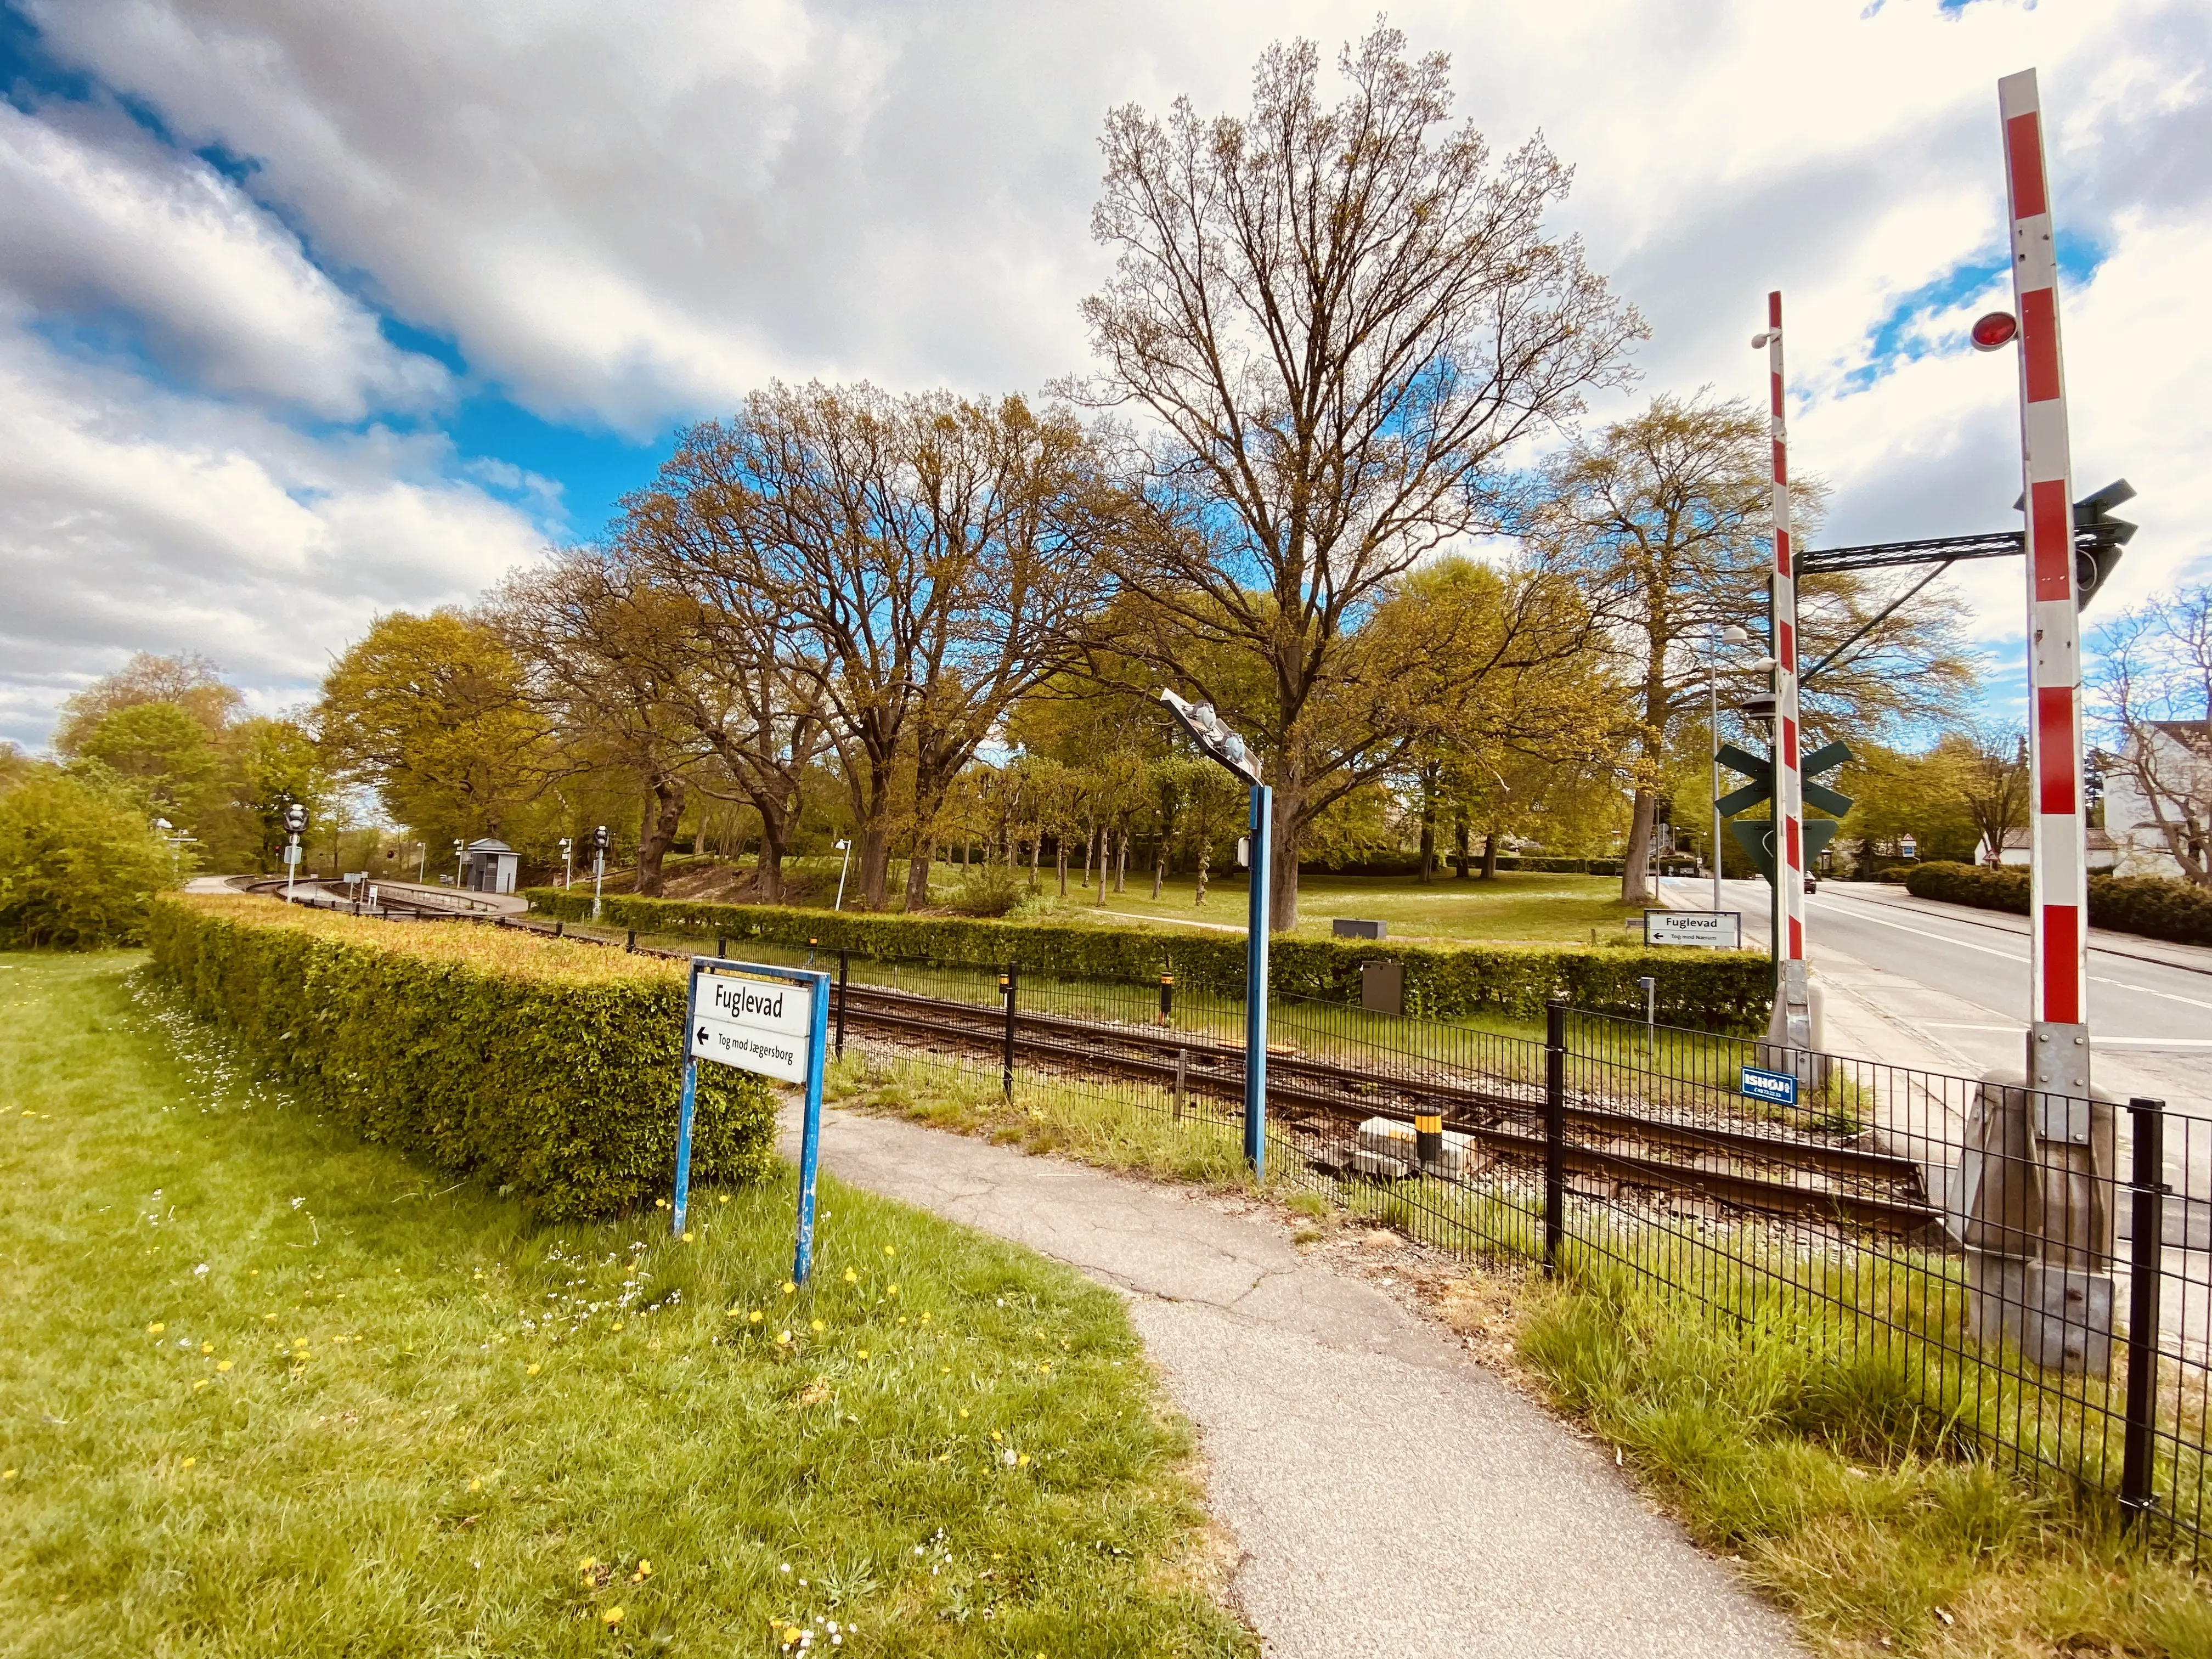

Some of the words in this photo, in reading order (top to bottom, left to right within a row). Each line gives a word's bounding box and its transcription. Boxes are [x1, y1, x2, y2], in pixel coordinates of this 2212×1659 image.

[1666, 917, 1718, 929] Fuglevad
[715, 984, 783, 1018] Fuglevad
[718, 1033, 730, 1050] Tog
[732, 1038, 748, 1051] mod
[749, 1040, 794, 1065] Jægersborg
[1745, 1074, 1784, 1092] ISHØJ
